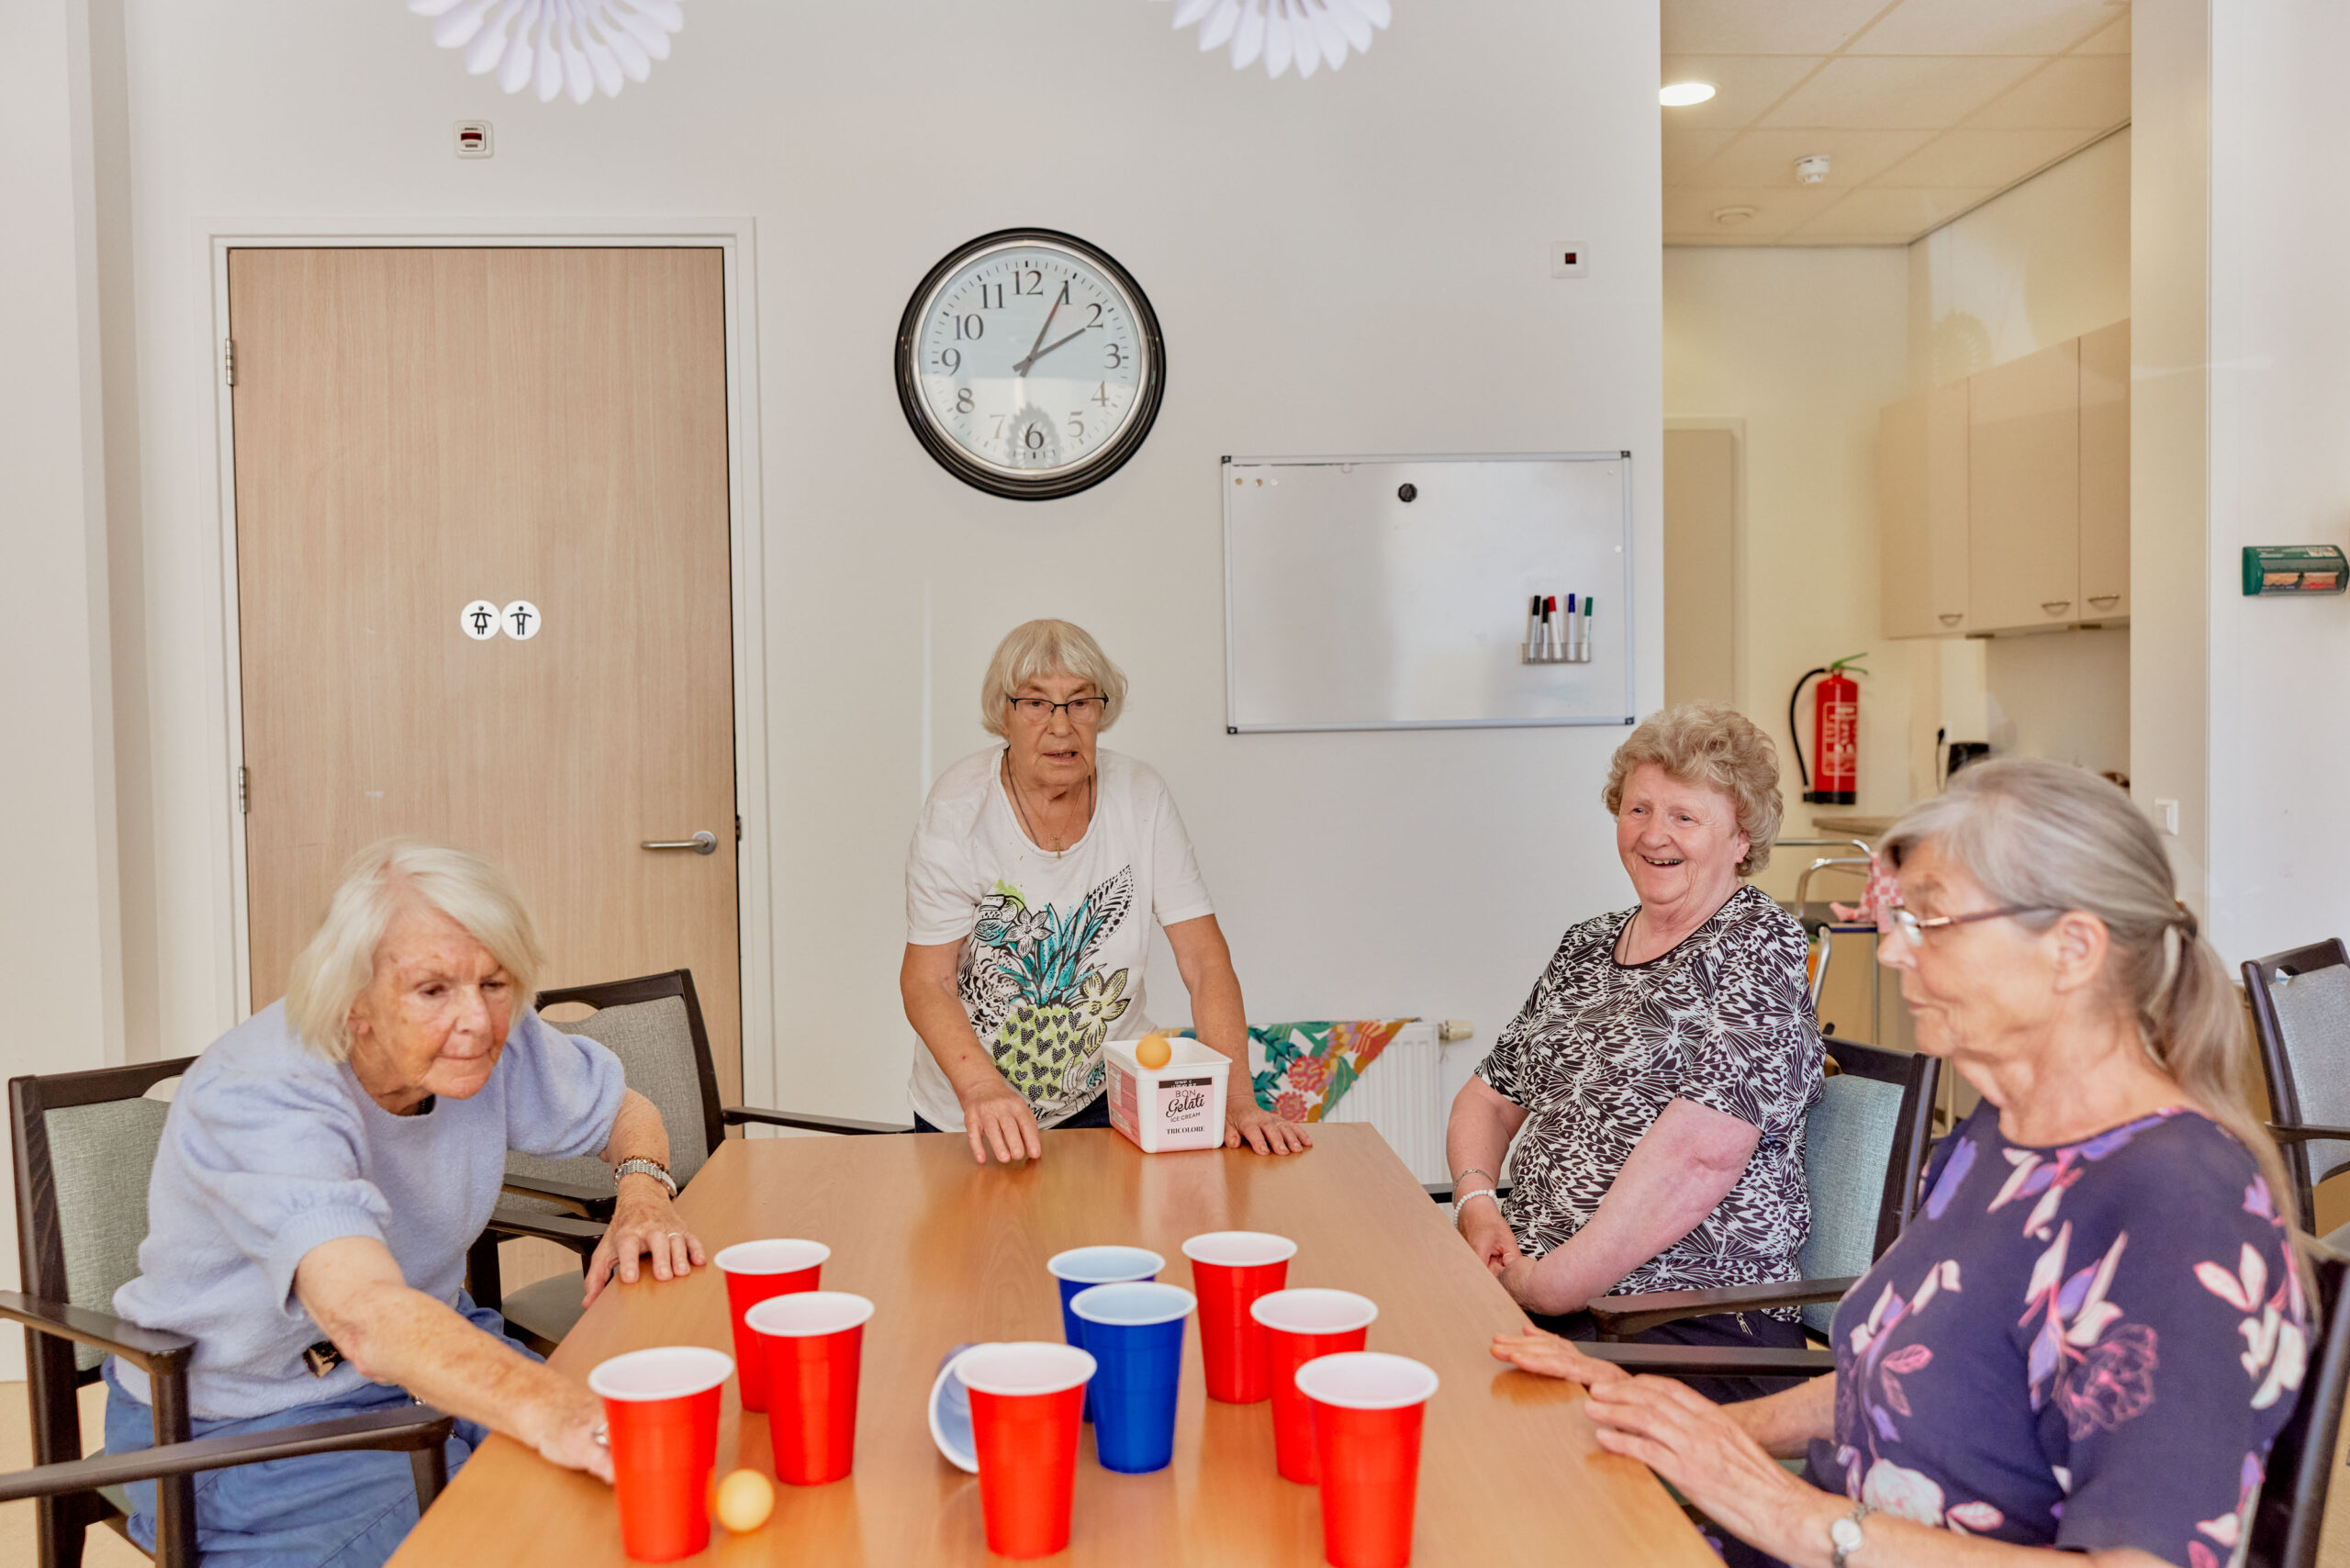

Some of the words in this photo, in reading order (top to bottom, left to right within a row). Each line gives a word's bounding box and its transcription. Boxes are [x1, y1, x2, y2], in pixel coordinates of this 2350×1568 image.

[979, 283, 1006, 309] 11
[1013, 270, 1044, 296] 12
[1061, 279, 1072, 306] 1
[953, 314, 984, 341] 10
[1086, 303, 1103, 329] 2
[941, 347, 961, 376] 9
[1104, 343, 1122, 369] 3
[956, 387, 975, 414] 8
[1091, 380, 1110, 407] 4
[990, 414, 1006, 440] 7
[1024, 420, 1045, 450] 6
[1068, 410, 1085, 438] 5
[1166, 1092, 1205, 1118] Gelati
[1175, 1089, 1196, 1098] BON
[1181, 1112, 1201, 1121] CREAM
[1167, 1126, 1204, 1135] TRICOLORE
